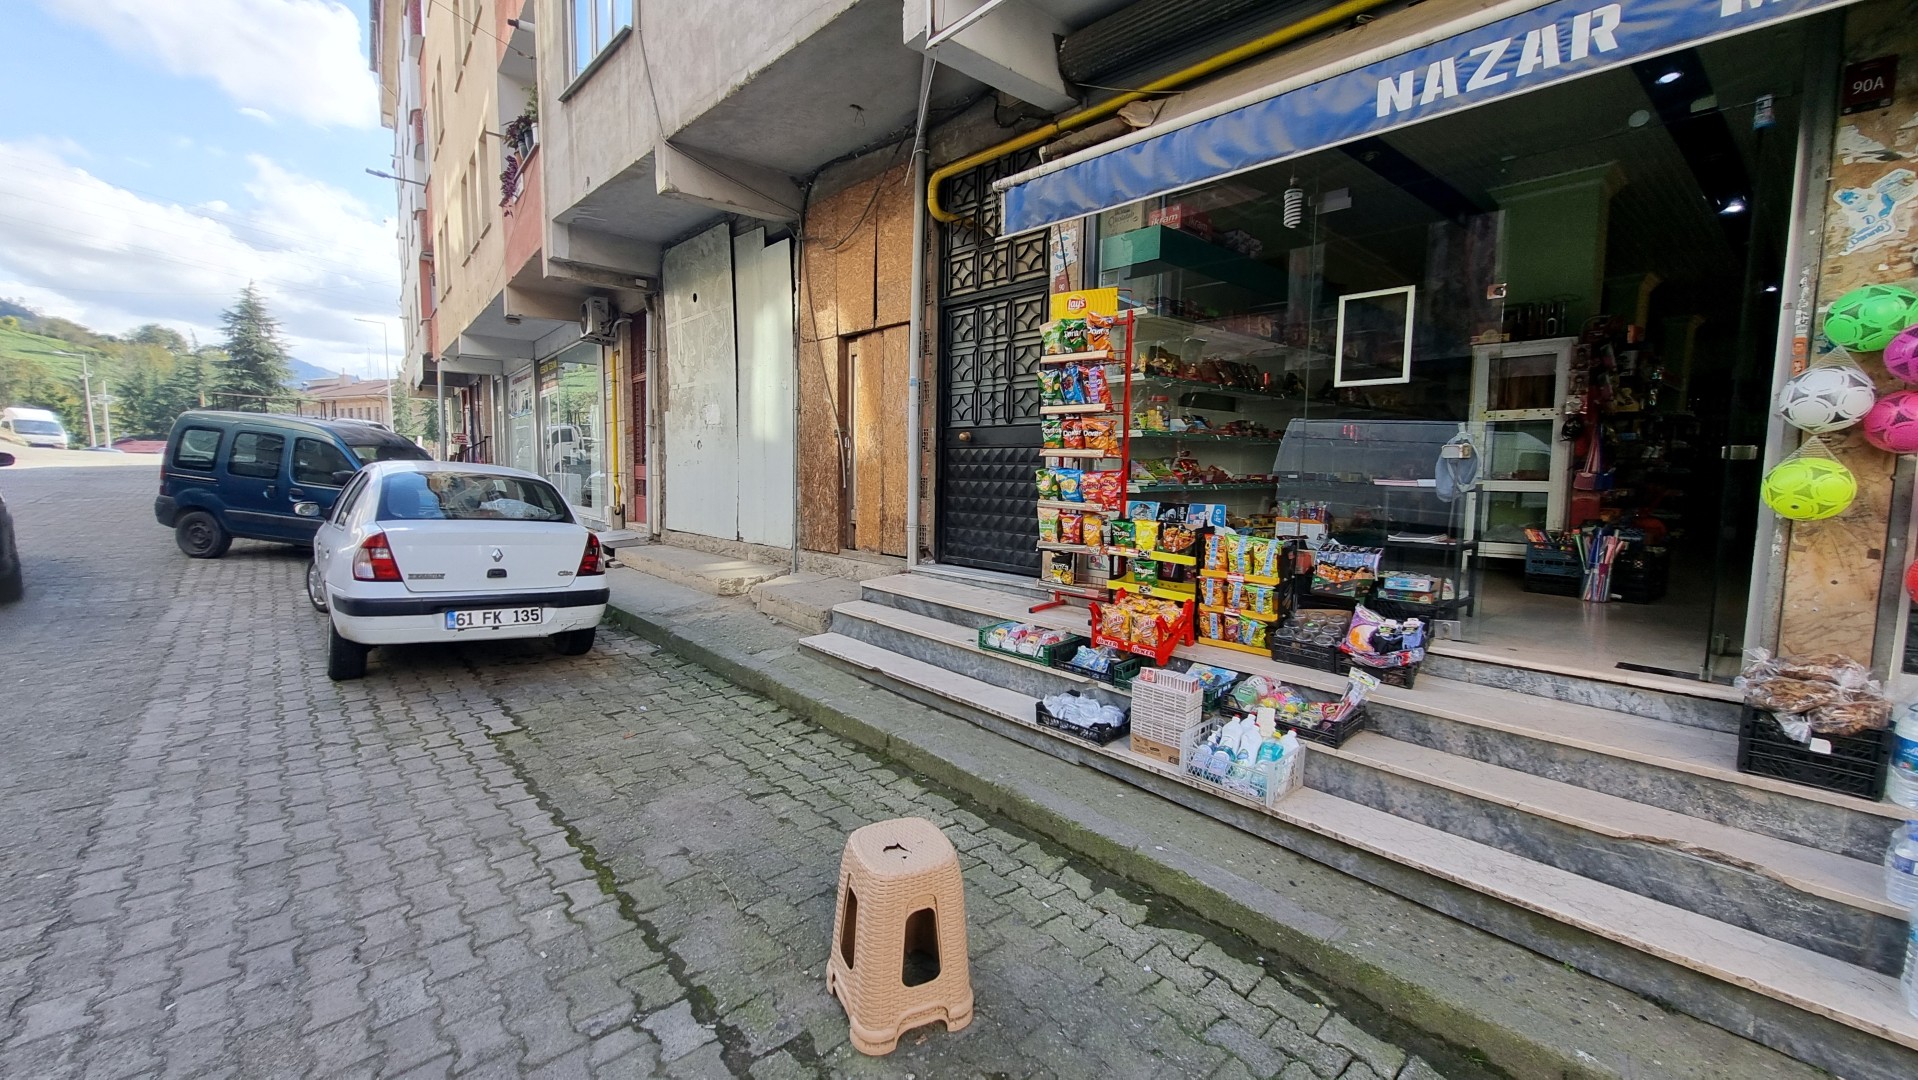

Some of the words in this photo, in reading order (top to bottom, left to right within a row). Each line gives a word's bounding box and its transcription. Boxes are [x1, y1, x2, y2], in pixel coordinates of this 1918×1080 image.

[1376, 3, 1621, 118] NAZAR
[1852, 76, 1884, 95] 90A
[456, 612, 474, 626] 61
[482, 610, 502, 625] FK
[513, 608, 540, 623] 135
